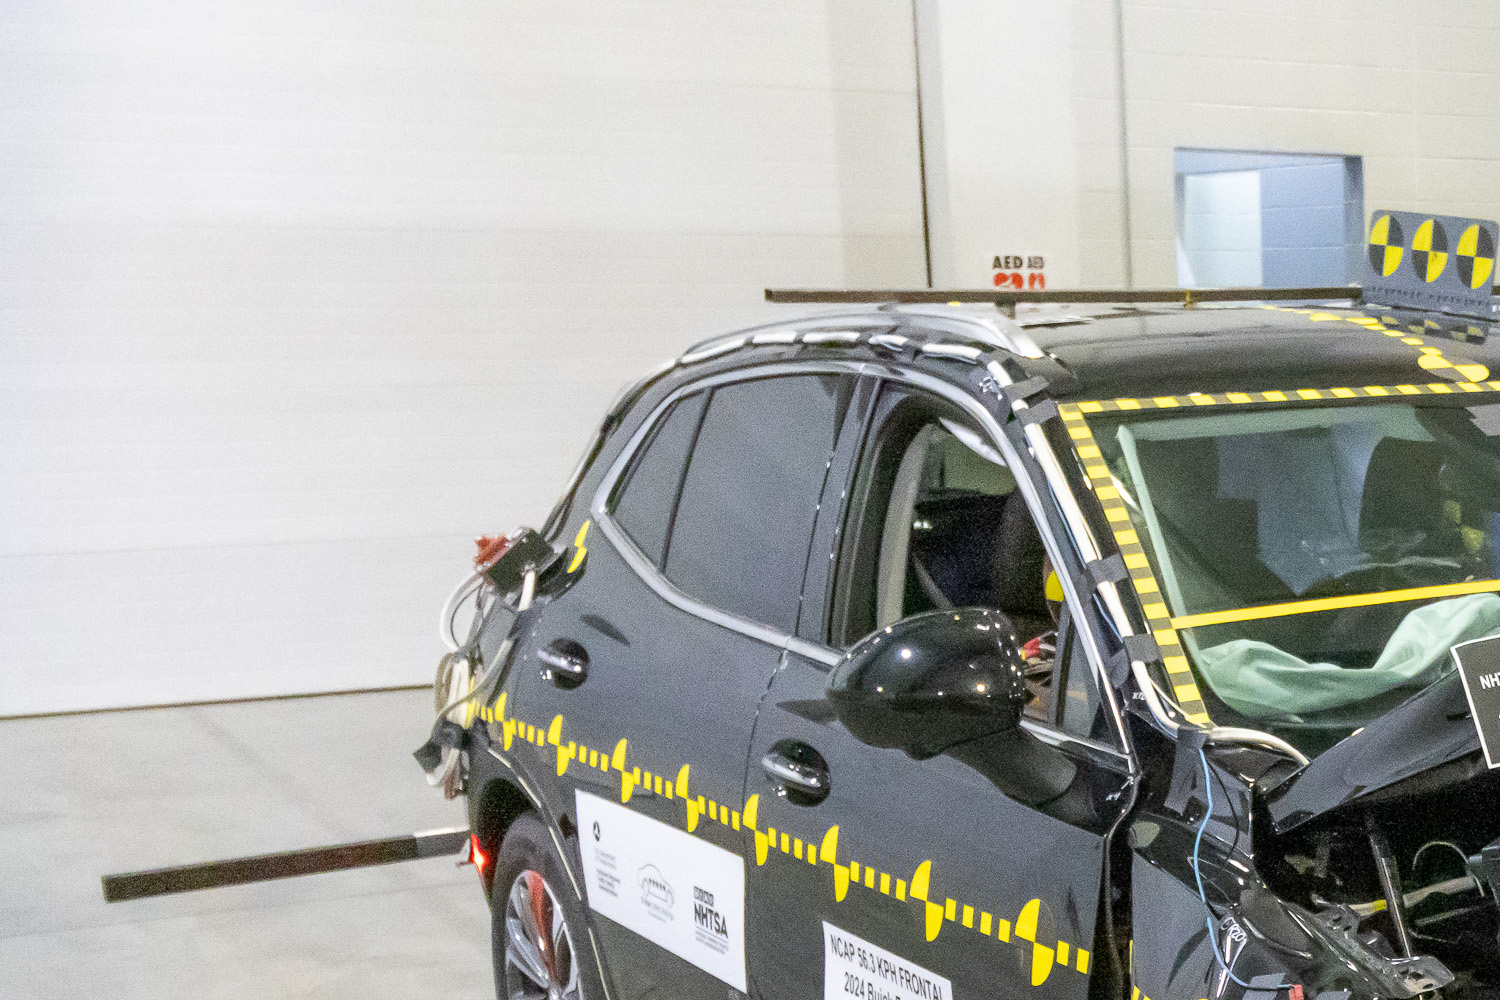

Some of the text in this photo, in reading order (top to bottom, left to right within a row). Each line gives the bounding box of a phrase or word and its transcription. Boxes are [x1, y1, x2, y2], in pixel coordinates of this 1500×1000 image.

[992, 255, 1023, 269] AED
[694, 902, 729, 939] NHTSA
[830, 934, 855, 963] NCAP
[857, 947, 876, 973] 56.3
[877, 957, 898, 984] KPH
[844, 972, 865, 995] 2024
